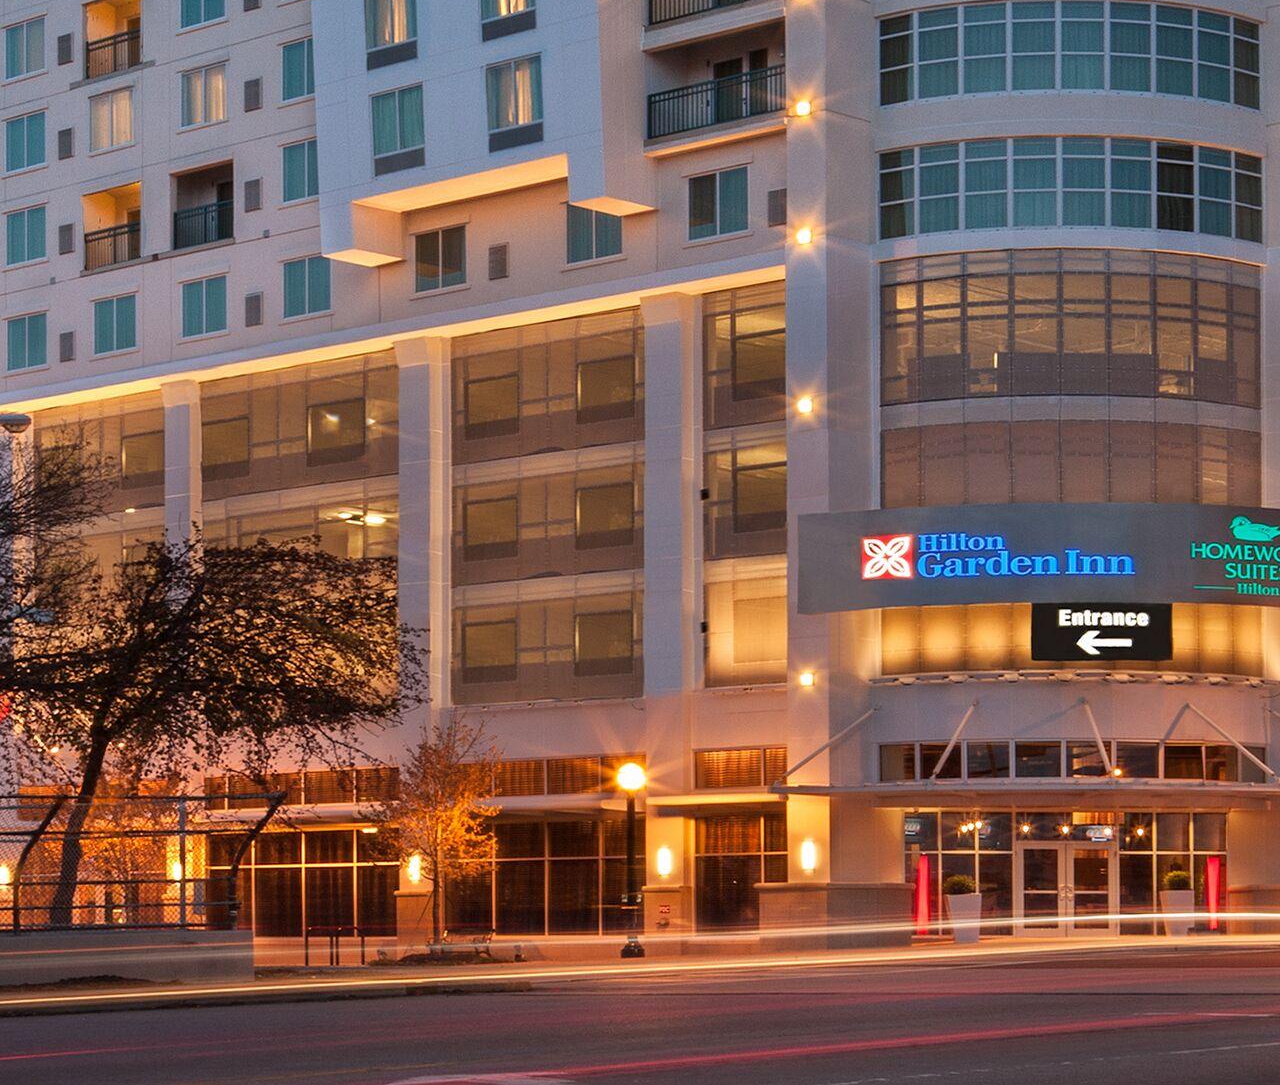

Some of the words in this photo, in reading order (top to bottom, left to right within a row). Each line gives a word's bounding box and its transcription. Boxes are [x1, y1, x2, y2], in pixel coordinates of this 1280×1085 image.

[918, 532, 1006, 553] Hilton
[917, 550, 1061, 578] Garden
[1065, 549, 1136, 576] Inn
[1236, 581, 1280, 597] Hilton
[1058, 608, 1150, 627] Entrance
